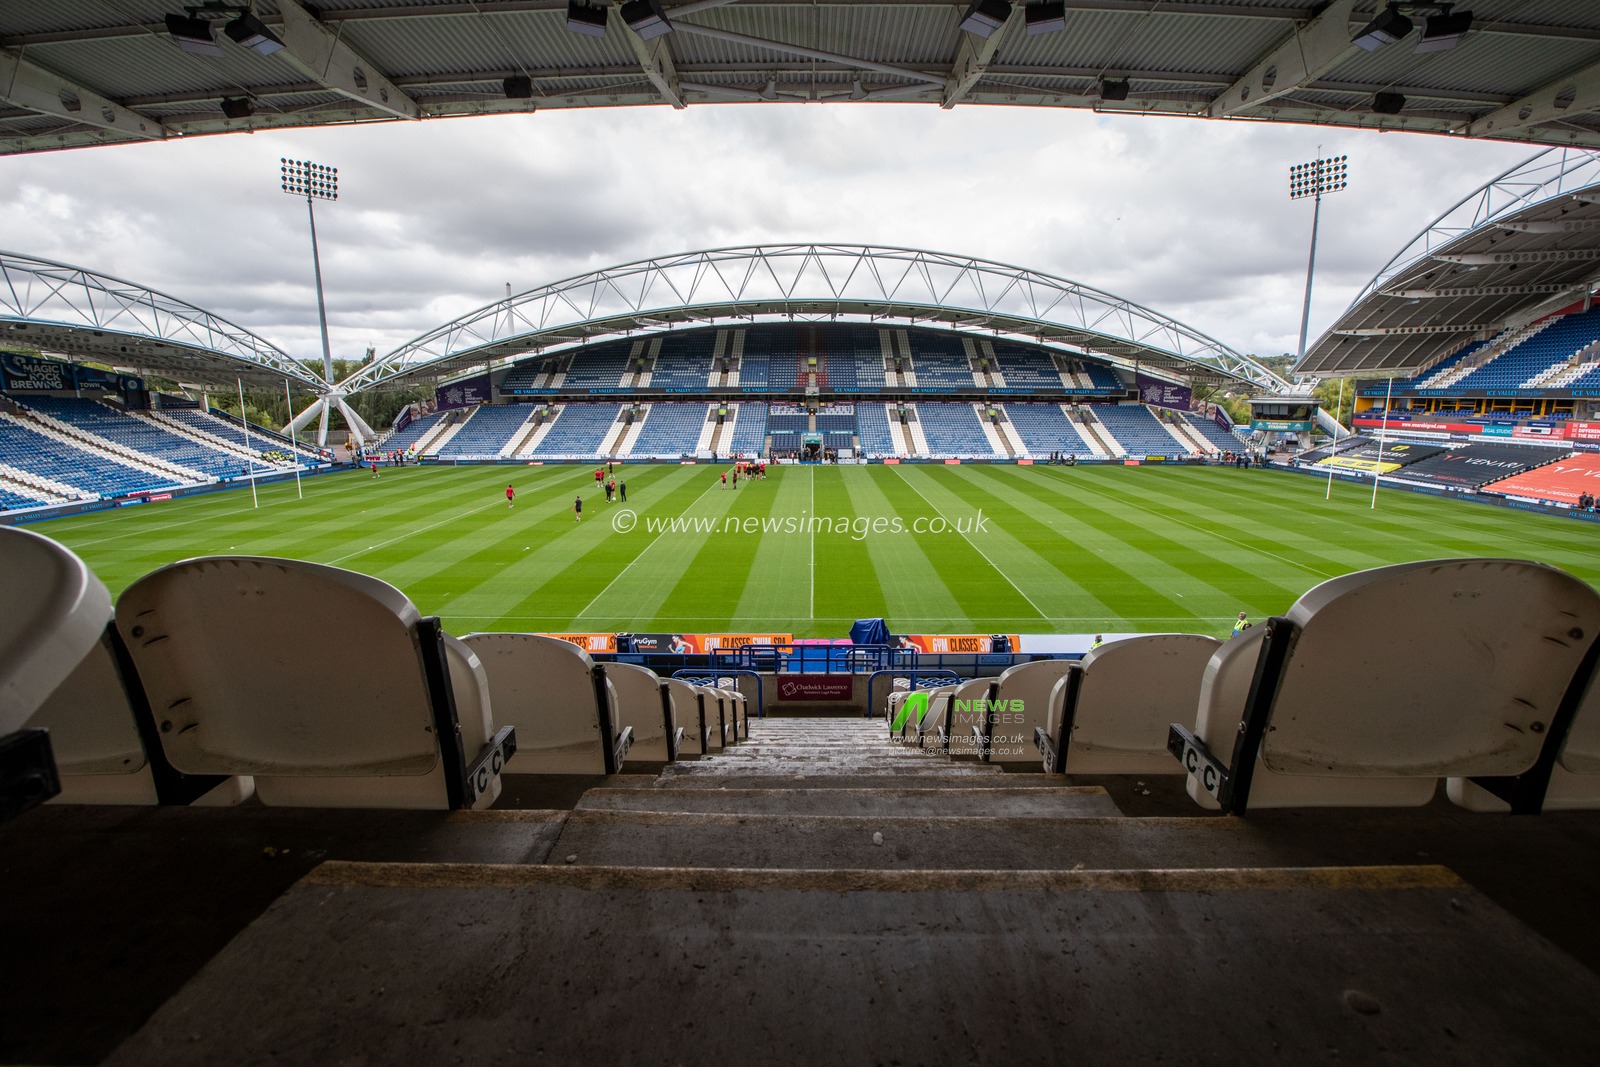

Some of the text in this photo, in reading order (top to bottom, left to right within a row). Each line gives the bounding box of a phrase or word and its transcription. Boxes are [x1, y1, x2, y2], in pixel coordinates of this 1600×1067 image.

[23, 364, 59, 373] MAGIC
[29, 373, 60, 381] ROCK
[10, 380, 63, 389] BREWING
[1465, 458, 1525, 468] VENARI
[588, 636, 607, 650] SWIM
[704, 637, 786, 651] GYM CLASSES SWIM SPA
[932, 638, 991, 652] GYM CLASSES SW
